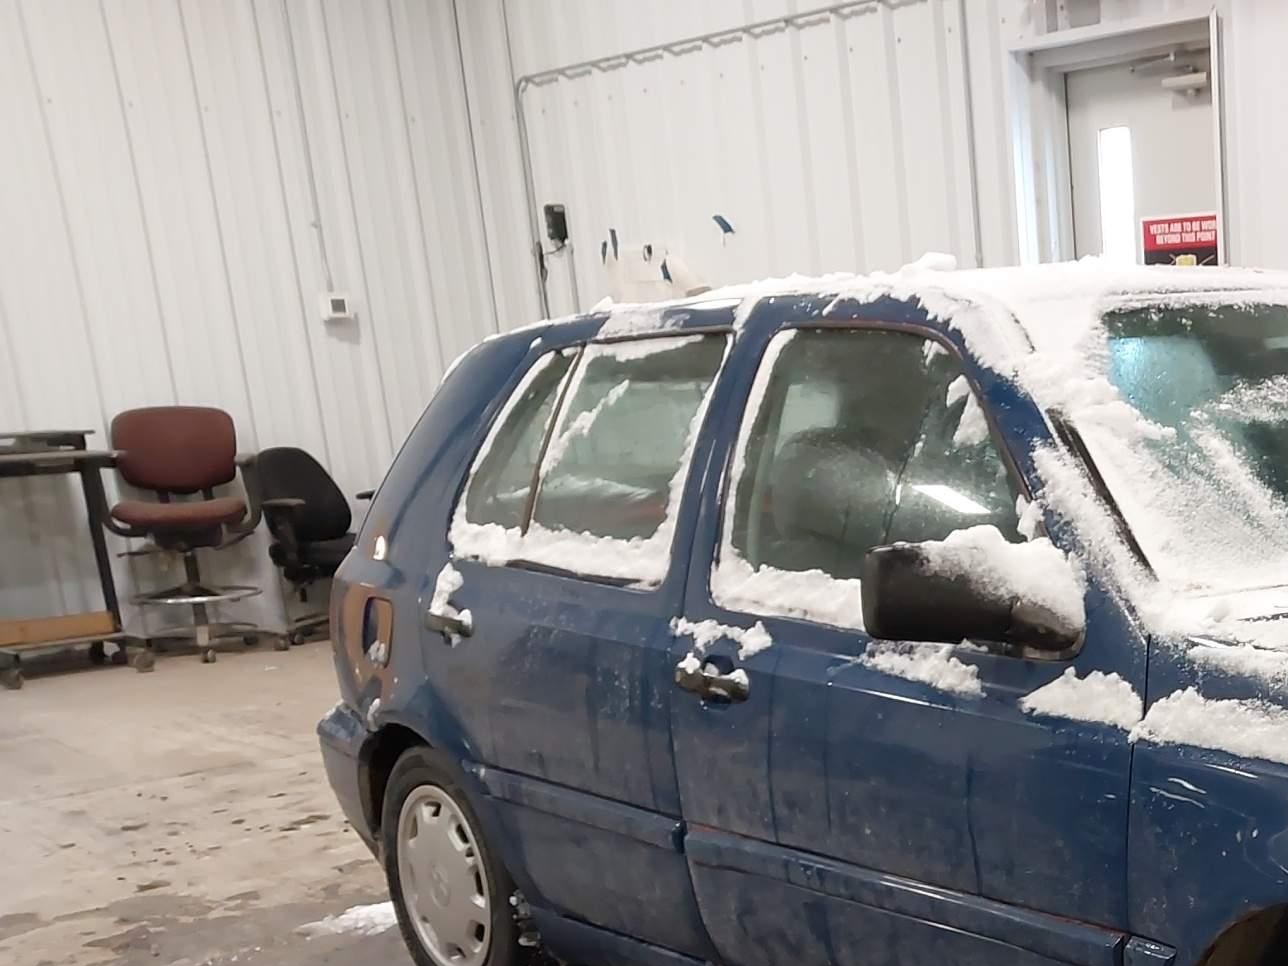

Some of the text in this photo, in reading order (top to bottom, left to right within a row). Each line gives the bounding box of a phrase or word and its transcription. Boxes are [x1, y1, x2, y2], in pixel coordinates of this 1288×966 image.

[1183, 221, 1192, 232] TO
[1192, 221, 1201, 231] BE
[1201, 220, 1217, 230] WOR
[1156, 230, 1216, 245] BEYOND THIS POINT
